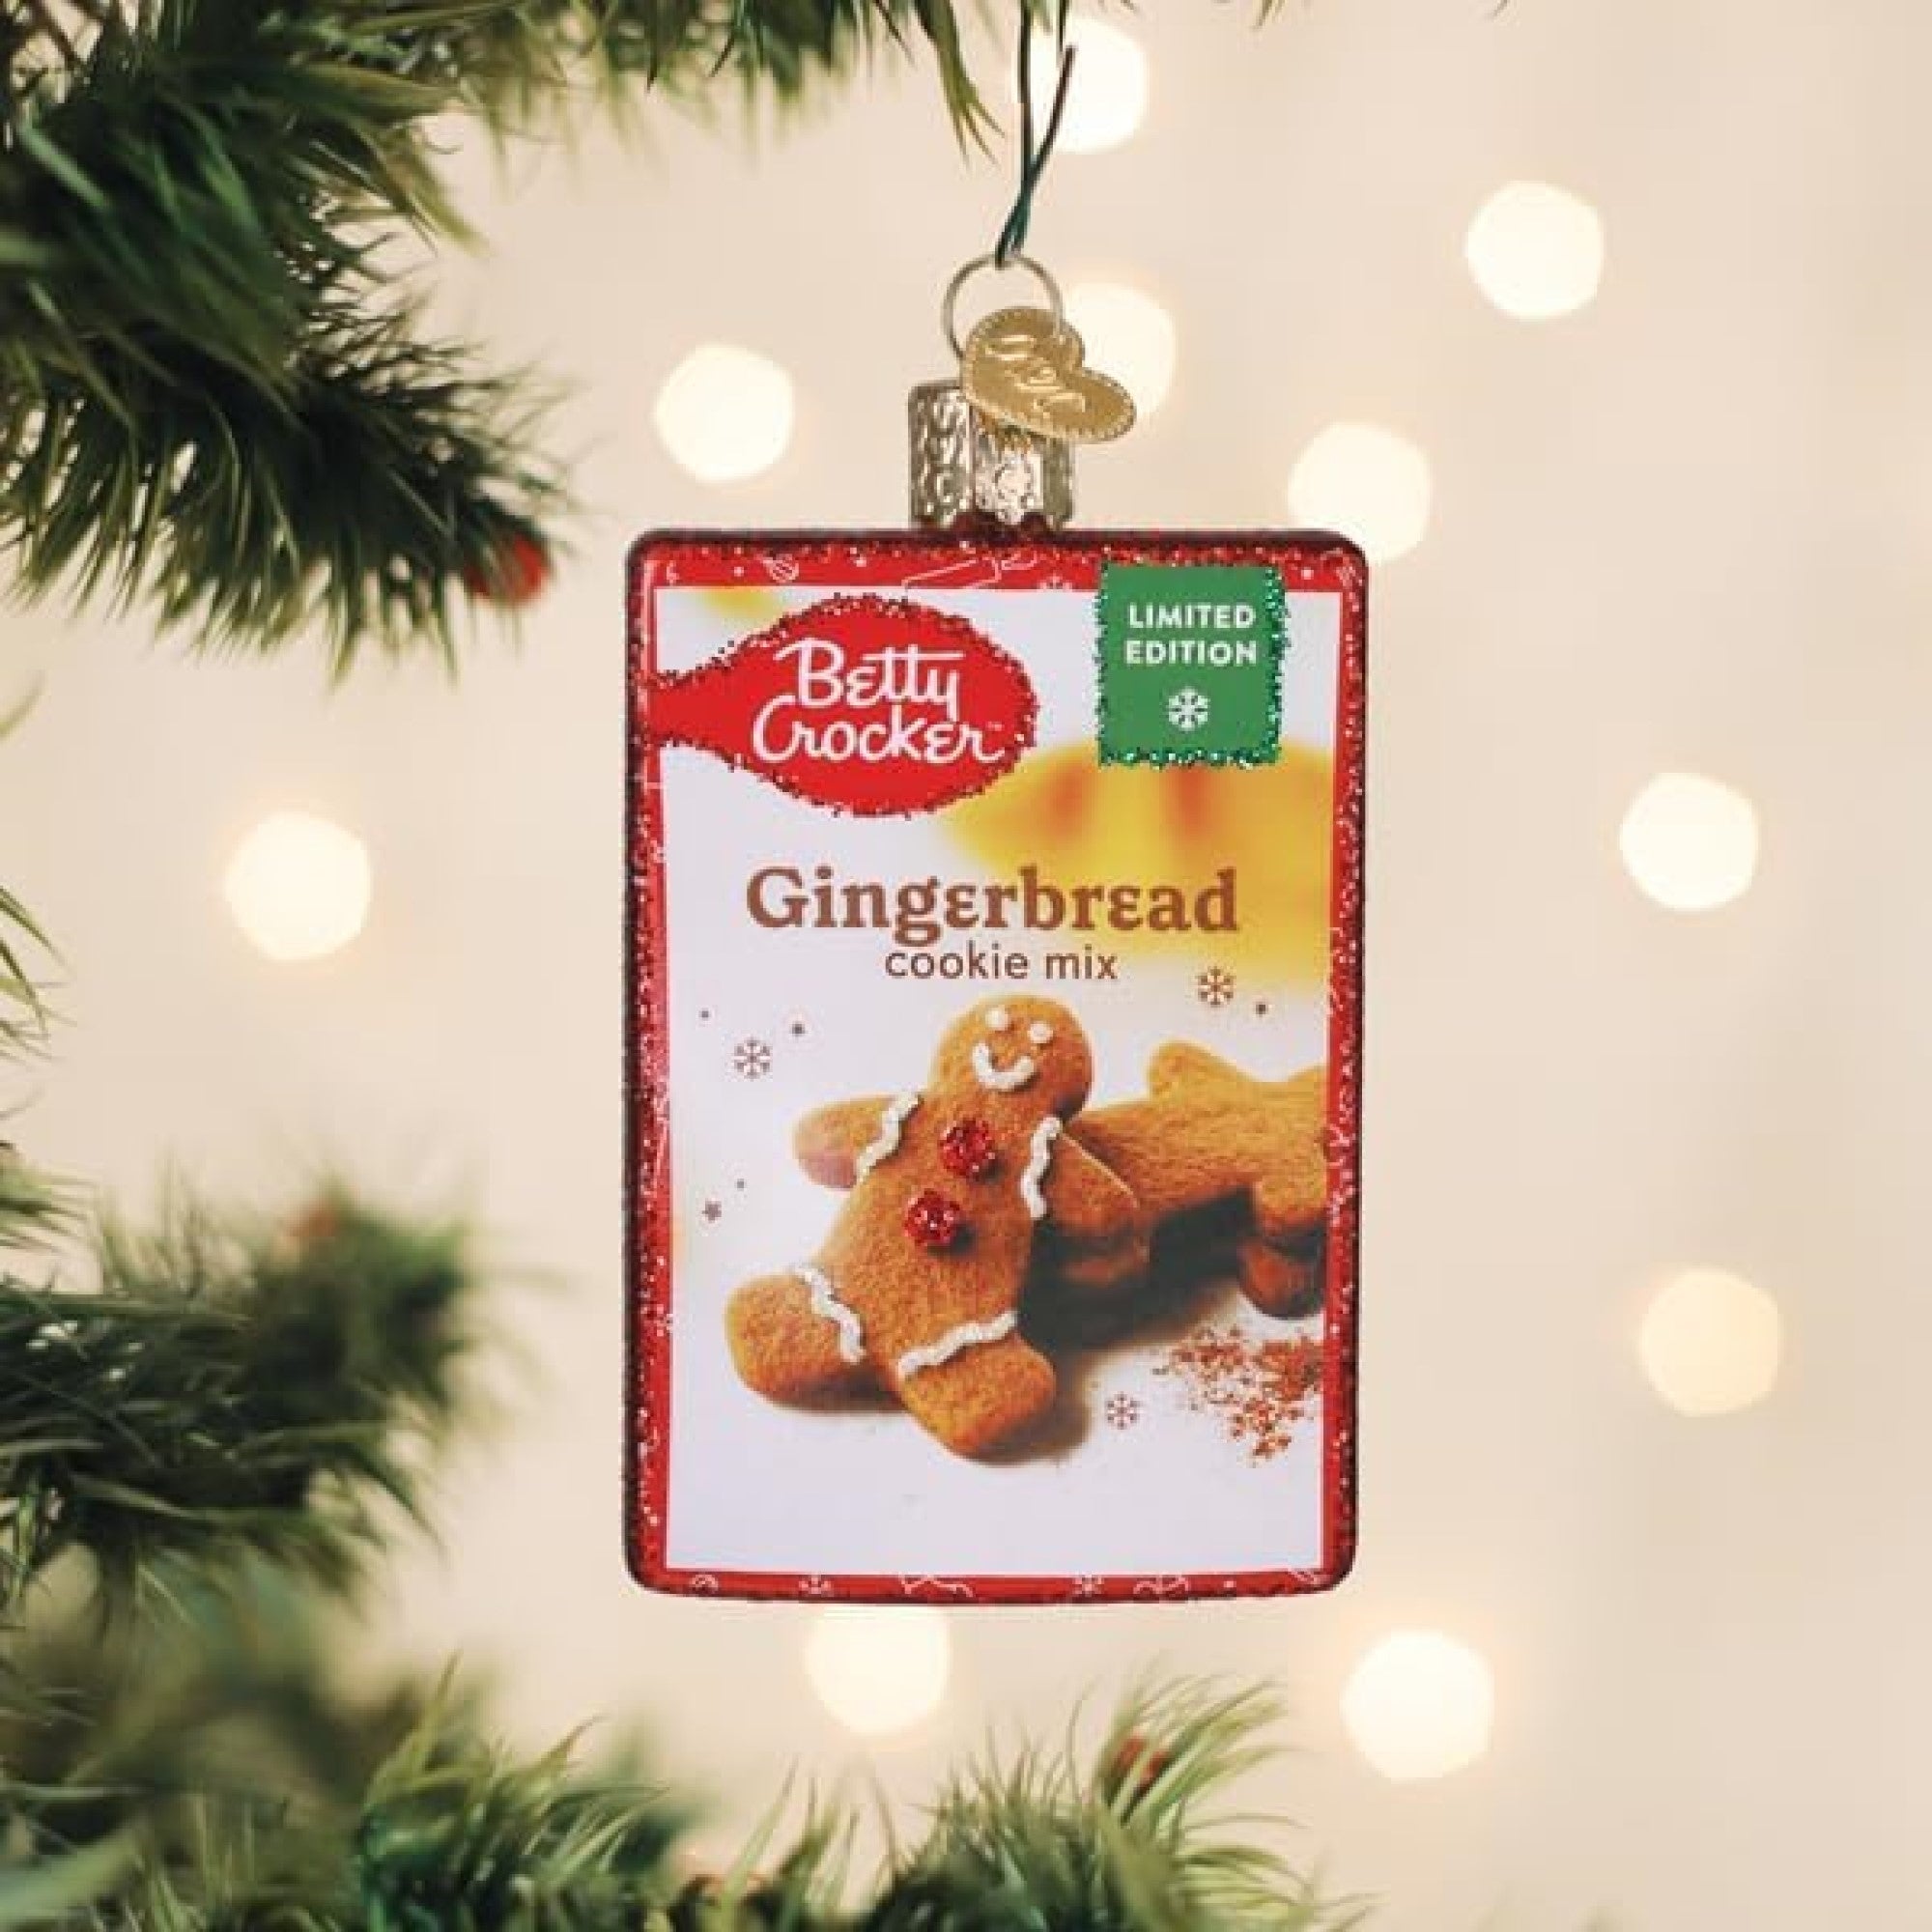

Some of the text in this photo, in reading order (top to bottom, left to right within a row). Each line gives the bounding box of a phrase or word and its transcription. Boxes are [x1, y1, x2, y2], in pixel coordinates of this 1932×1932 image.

[1128, 603, 1257, 629] LIMITED
[774, 637, 964, 721] Betty
[1125, 640, 1258, 666] EDITION
[752, 694, 1006, 763] Crocker
[746, 866, 1238, 947] Gingerbread
[885, 942, 1119, 980] cookie mix
